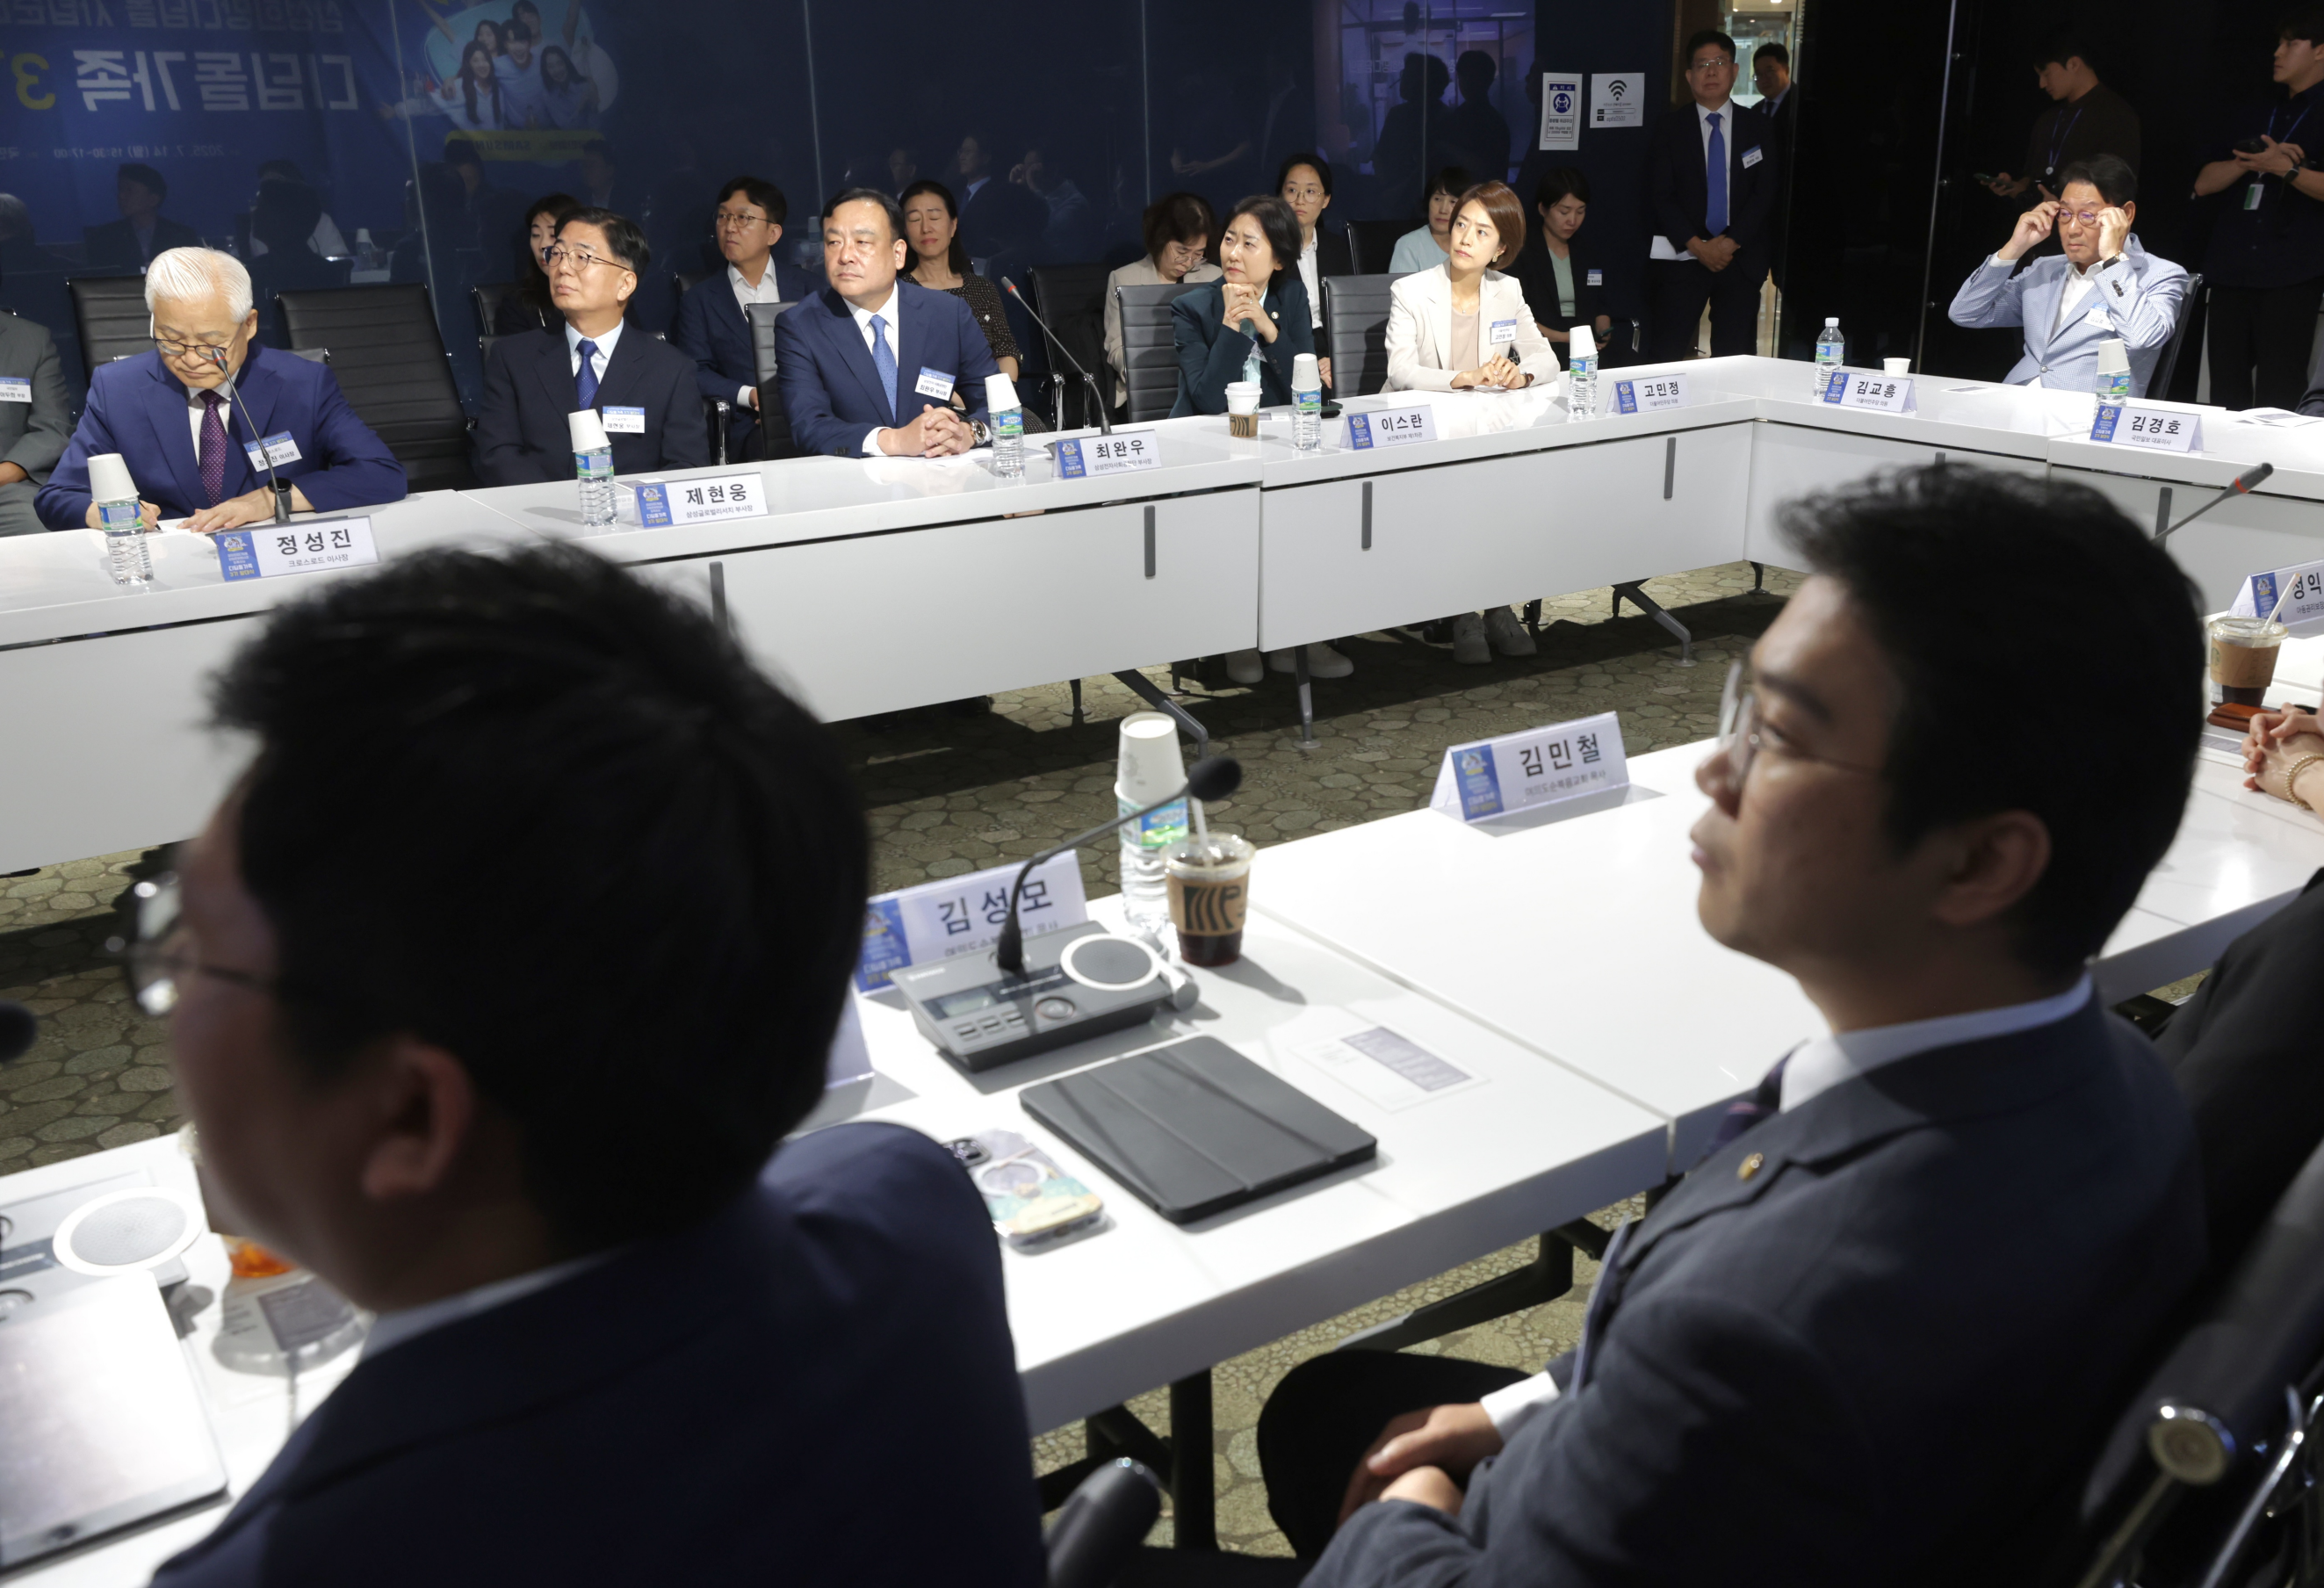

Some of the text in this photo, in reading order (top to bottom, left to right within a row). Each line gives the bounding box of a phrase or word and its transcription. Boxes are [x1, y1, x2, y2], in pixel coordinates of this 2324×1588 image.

[1644, 381, 1679, 397] 고민정
[1857, 381, 1897, 399] 김교흥
[1856, 397, 1880, 406] 더불어민주당
[1381, 414, 1423, 431] 이스란
[2132, 415, 2181, 435] 김경호
[1387, 433, 1407, 442] 보건복지부
[1096, 439, 1144, 458] 최완우
[257, 451, 295, 467] 정진 이사장
[685, 483, 747, 505] 제현웅
[686, 504, 754, 519] 삼성글로벌리서치 부사장
[277, 528, 352, 555] 정성진
[288, 553, 350, 567] 크로스로드 이사장
[1519, 733, 1602, 777] 김민철
[938, 880, 1053, 936] 김성모
